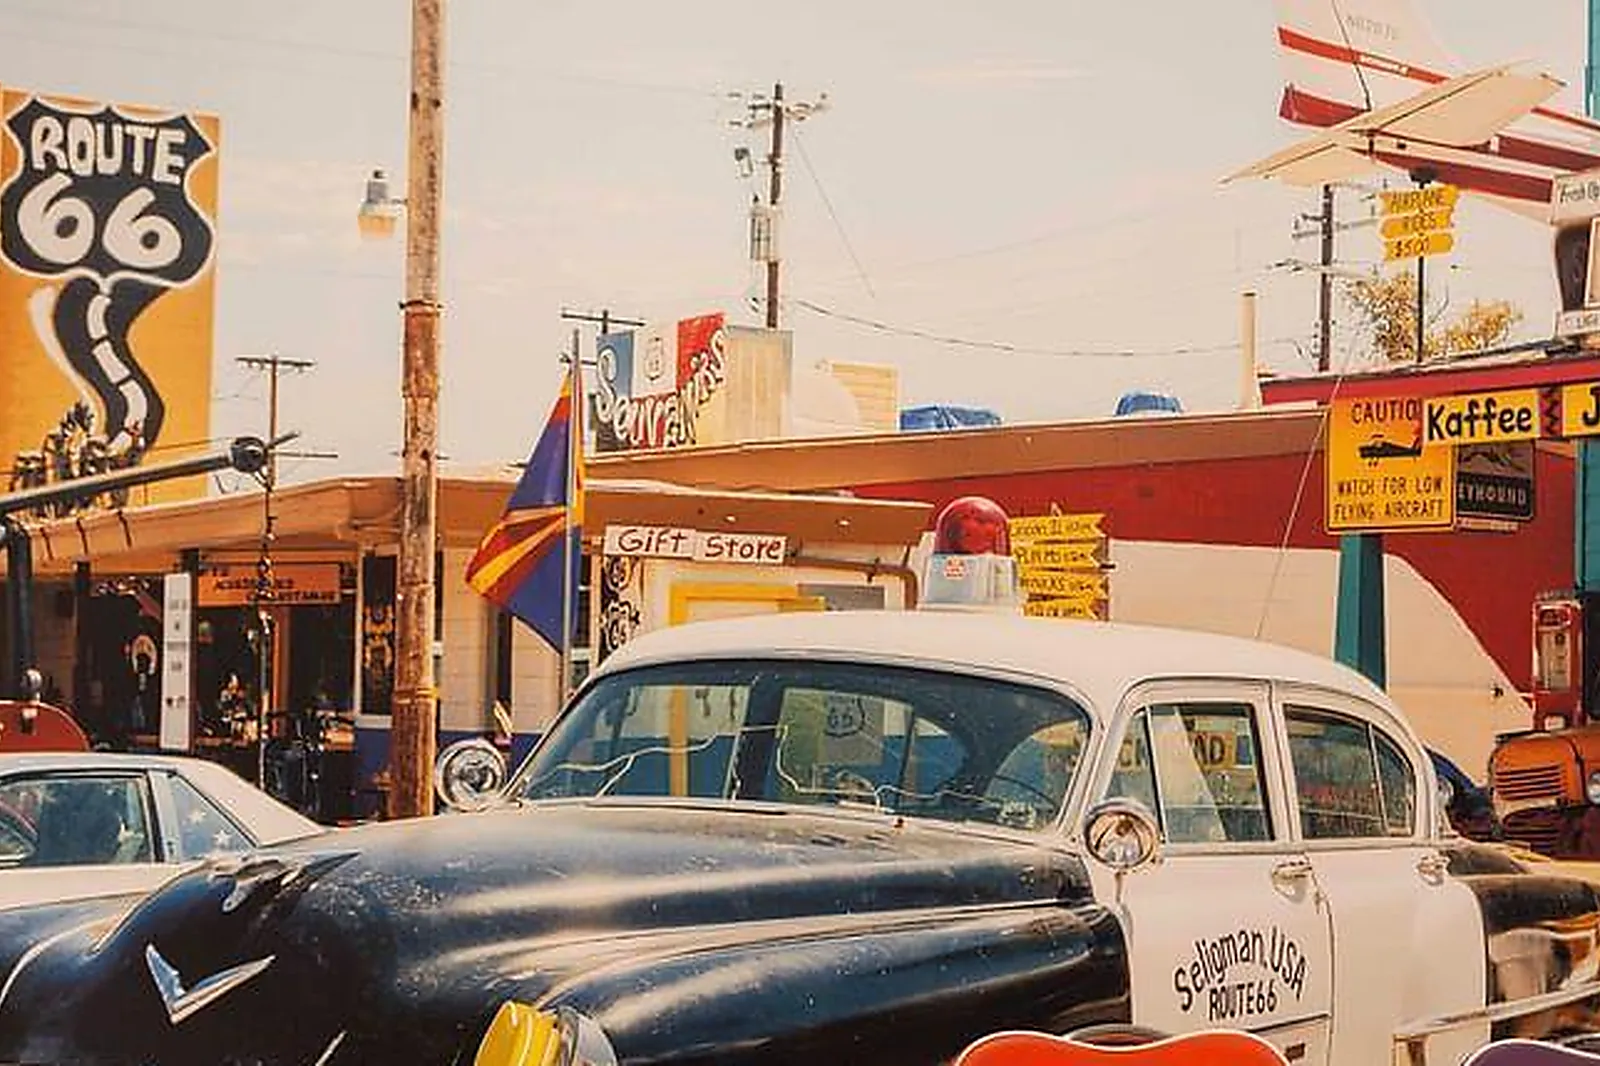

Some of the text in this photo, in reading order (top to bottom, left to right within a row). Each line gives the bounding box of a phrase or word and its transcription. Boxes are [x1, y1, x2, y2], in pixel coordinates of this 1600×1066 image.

[31, 116, 185, 184] ROUTE
[18, 173, 183, 270] 66
[1351, 398, 1420, 425] CAUTIO
[1427, 398, 1533, 441] Kaffee
[1337, 475, 1443, 497] WATCH FOR LOW
[1334, 498, 1444, 521] FLYING AIRCRAFT
[618, 528, 782, 560] Gift Store
